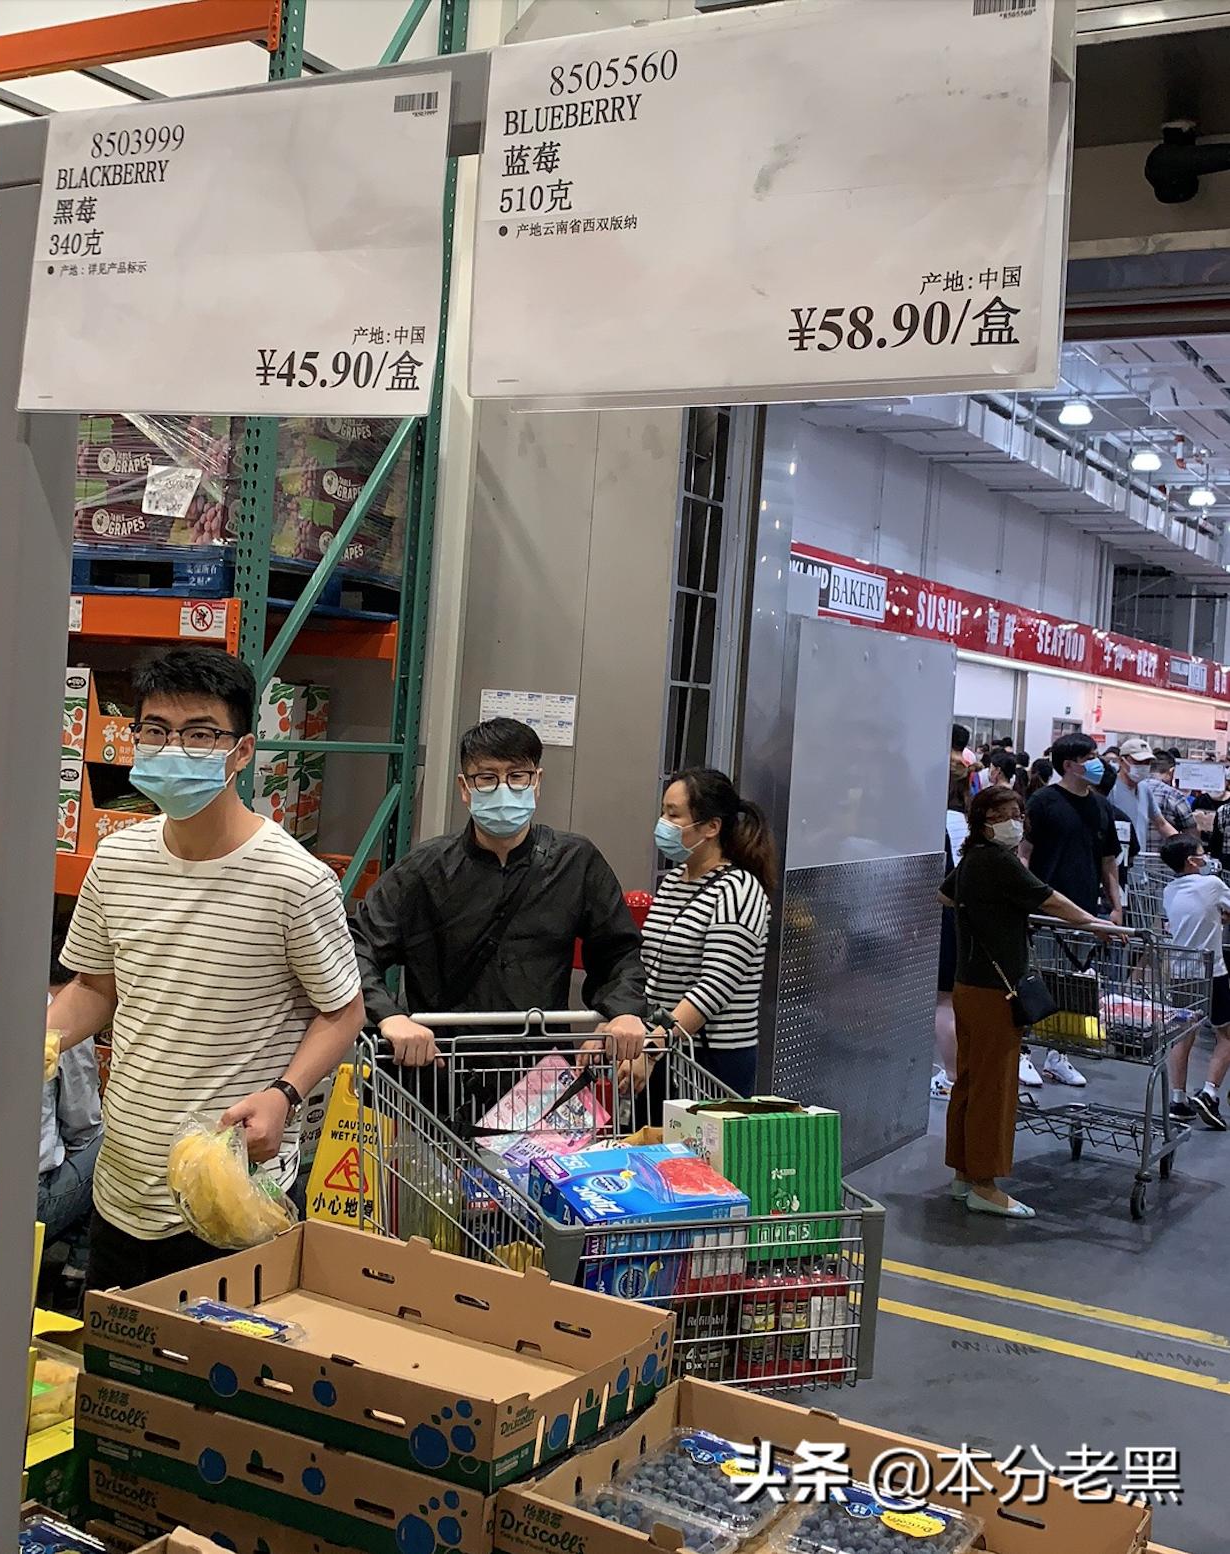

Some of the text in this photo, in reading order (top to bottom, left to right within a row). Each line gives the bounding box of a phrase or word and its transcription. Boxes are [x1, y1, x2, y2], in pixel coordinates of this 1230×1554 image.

[549, 49, 678, 97] 8505560
[503, 93, 643, 136] BLUEBERRY
[90, 124, 186, 159] 8503999
[55, 159, 170, 190] BLACKBERRY
[501, 141, 562, 178] 蓝莓
[53, 196, 98, 225] 黑莓
[499, 178, 575, 214] 510克
[48, 228, 105, 257] 340克
[516, 214, 638, 239] 产地云南省西双版纳
[919, 265, 1022, 296] 产地:中国
[351, 325, 426, 346] 产地:中国
[787, 295, 1022, 351] ¥58.90/盒
[255, 349, 424, 391] ¥45.90/盒
[340, 424, 372, 441] GRAPES
[115, 453, 153, 473] GRAPES
[108, 516, 146, 536] GRAPES
[831, 574, 885, 612] BAKERY
[916, 590, 962, 636] SUSHI
[1036, 621, 1086, 663] SEAFOOD
[331, 1129, 350, 1141] WET
[572, 1184, 625, 1217] Ziploc
[89, 1310, 157, 1345] Driscoll's
[79, 1392, 148, 1430] Driscoll's
[499, 1508, 586, 1554] Driscoll's
